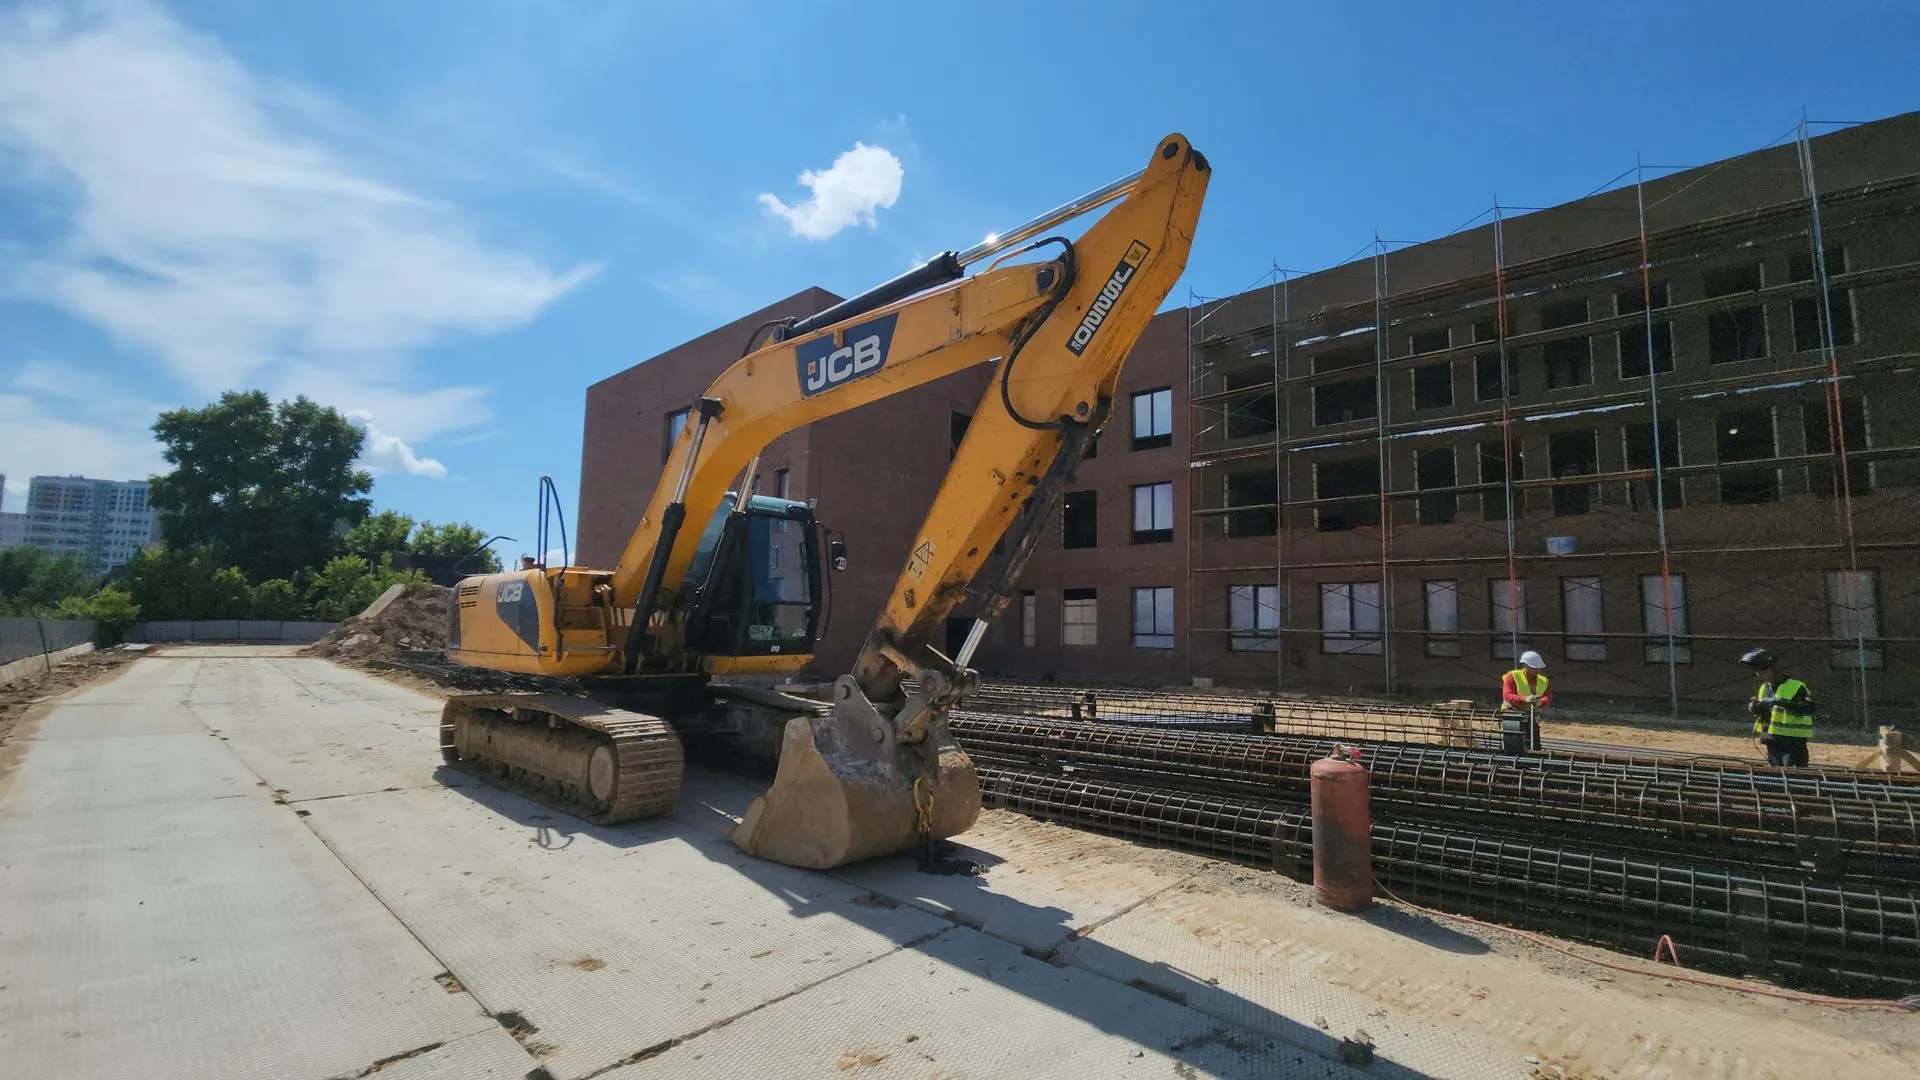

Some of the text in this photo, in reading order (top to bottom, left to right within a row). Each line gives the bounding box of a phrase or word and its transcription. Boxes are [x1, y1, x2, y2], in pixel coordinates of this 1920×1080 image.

[1074, 268, 1133, 346] JS220
[808, 335, 881, 391] JCB
[497, 583, 524, 603] JCB
